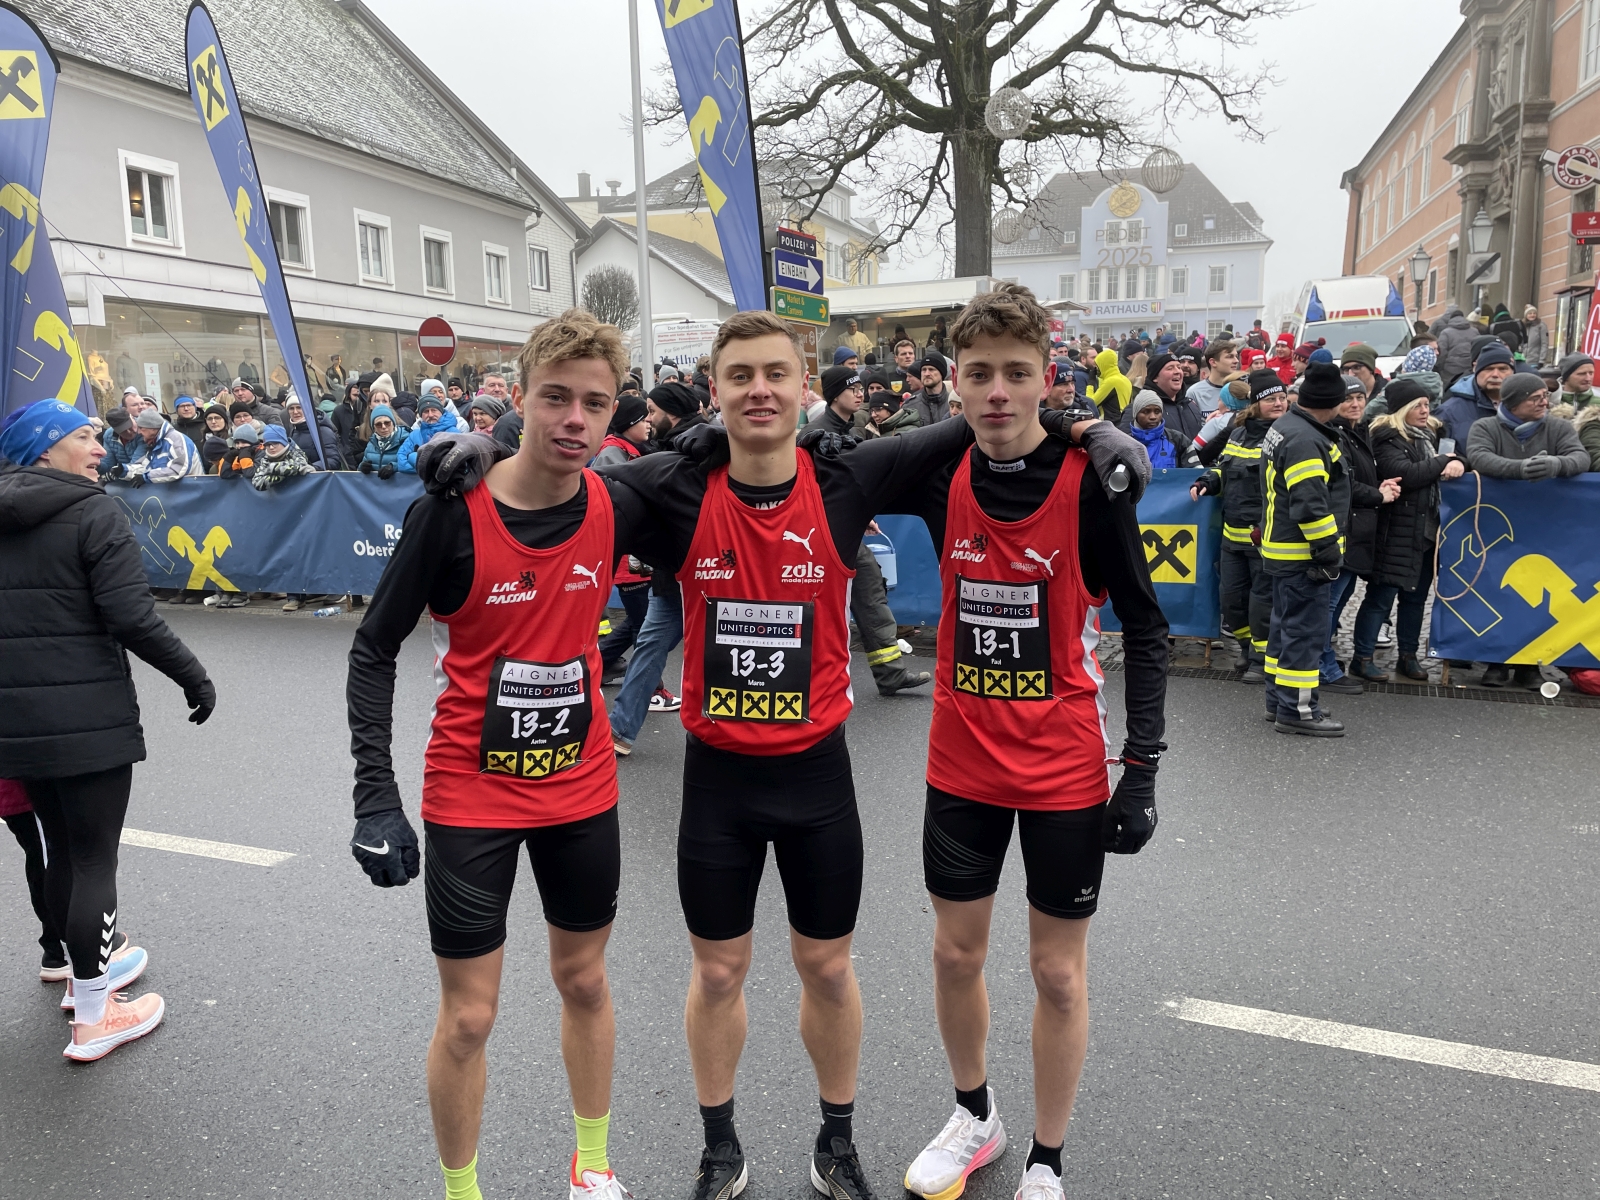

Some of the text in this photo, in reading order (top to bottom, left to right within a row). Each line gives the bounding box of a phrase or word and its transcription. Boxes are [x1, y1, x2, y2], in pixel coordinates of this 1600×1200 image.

[1566, 148, 1597, 164] TABAK
[1558, 164, 1588, 185] TRAFIK
[781, 235, 806, 250] POLIZEI
[1097, 246, 1153, 269] 2025
[781, 263, 807, 279] EINBAHN
[1095, 304, 1148, 315] RATHAUS
[1256, 385, 1283, 400] FEUERWEHR
[696, 558, 719, 568] LAC
[694, 570, 735, 580] PASSAU
[492, 581, 519, 593] LAC
[963, 586, 1030, 600] AIGNER
[485, 590, 537, 604] PASSAU
[721, 607, 794, 620] AIGNER
[972, 627, 1021, 659] 13-1
[730, 647, 785, 679] 13-3
[506, 667, 578, 680] AIGNER
[747, 679, 765, 687] Marco
[511, 708, 571, 739] 13-2
[104, 1014, 141, 1031] HOKA
